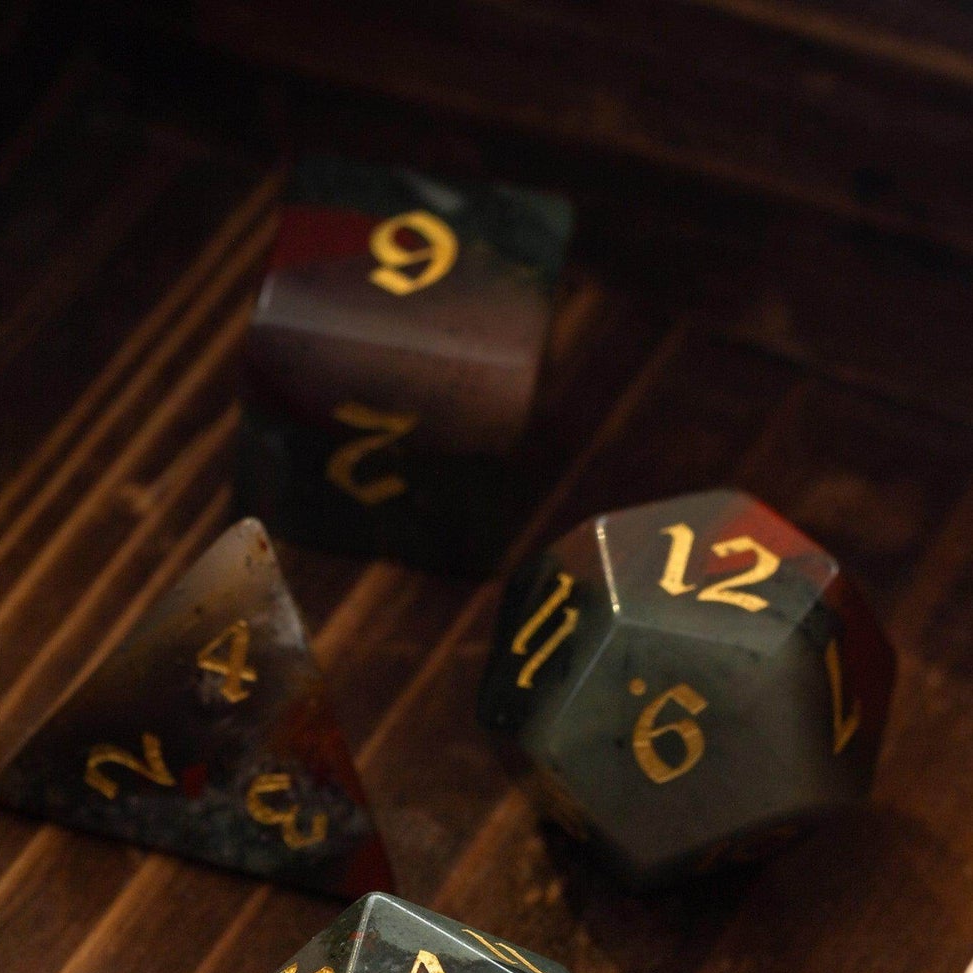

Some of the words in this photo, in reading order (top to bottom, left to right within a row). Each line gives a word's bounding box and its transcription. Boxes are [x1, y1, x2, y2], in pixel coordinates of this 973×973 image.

[327, 402, 420, 505] 2
[658, 522, 781, 612] 12
[196, 619, 258, 704] 4
[511, 572, 580, 689] 11
[83, 731, 177, 800] 2
[246, 773, 327, 851] 3
